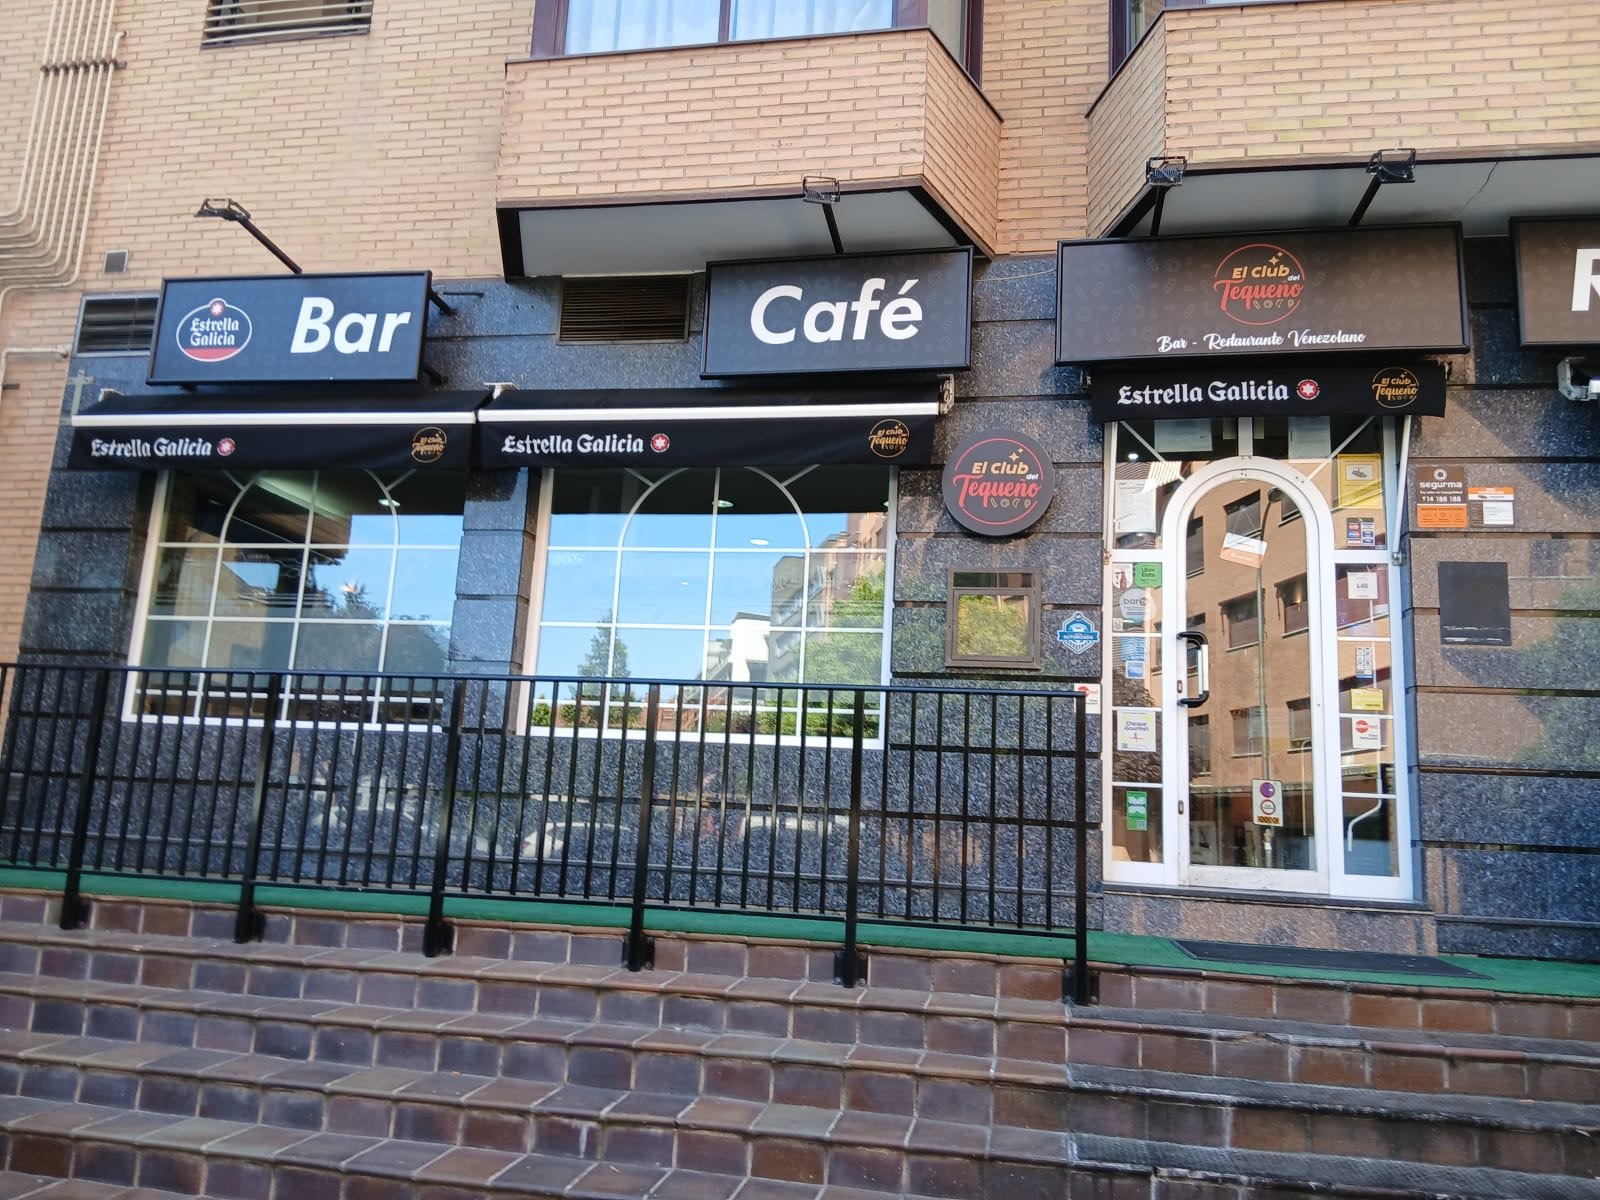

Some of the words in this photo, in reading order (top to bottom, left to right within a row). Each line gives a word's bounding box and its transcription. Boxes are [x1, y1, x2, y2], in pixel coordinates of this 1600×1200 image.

[1231, 266, 1248, 279] El
[1213, 278, 1304, 310] Tequeño
[750, 277, 923, 345] Café
[190, 317, 239, 332] Estrella
[290, 296, 412, 354] Bar
[190, 331, 235, 346] Galicia
[1156, 335, 1187, 352] Bar
[1203, 331, 1284, 350] Restaurante
[1287, 328, 1367, 347] Venezolano
[1117, 383, 1203, 405] Estrella
[1207, 380, 1289, 401] Galicia
[90, 438, 151, 457] Estrella
[153, 437, 212, 456] Galicia
[501, 434, 573, 454] Estrella
[576, 433, 644, 453] Galicia
[971, 461, 988, 474] El
[953, 474, 1041, 507] Tequeño
[1419, 481, 1463, 489] segurma
